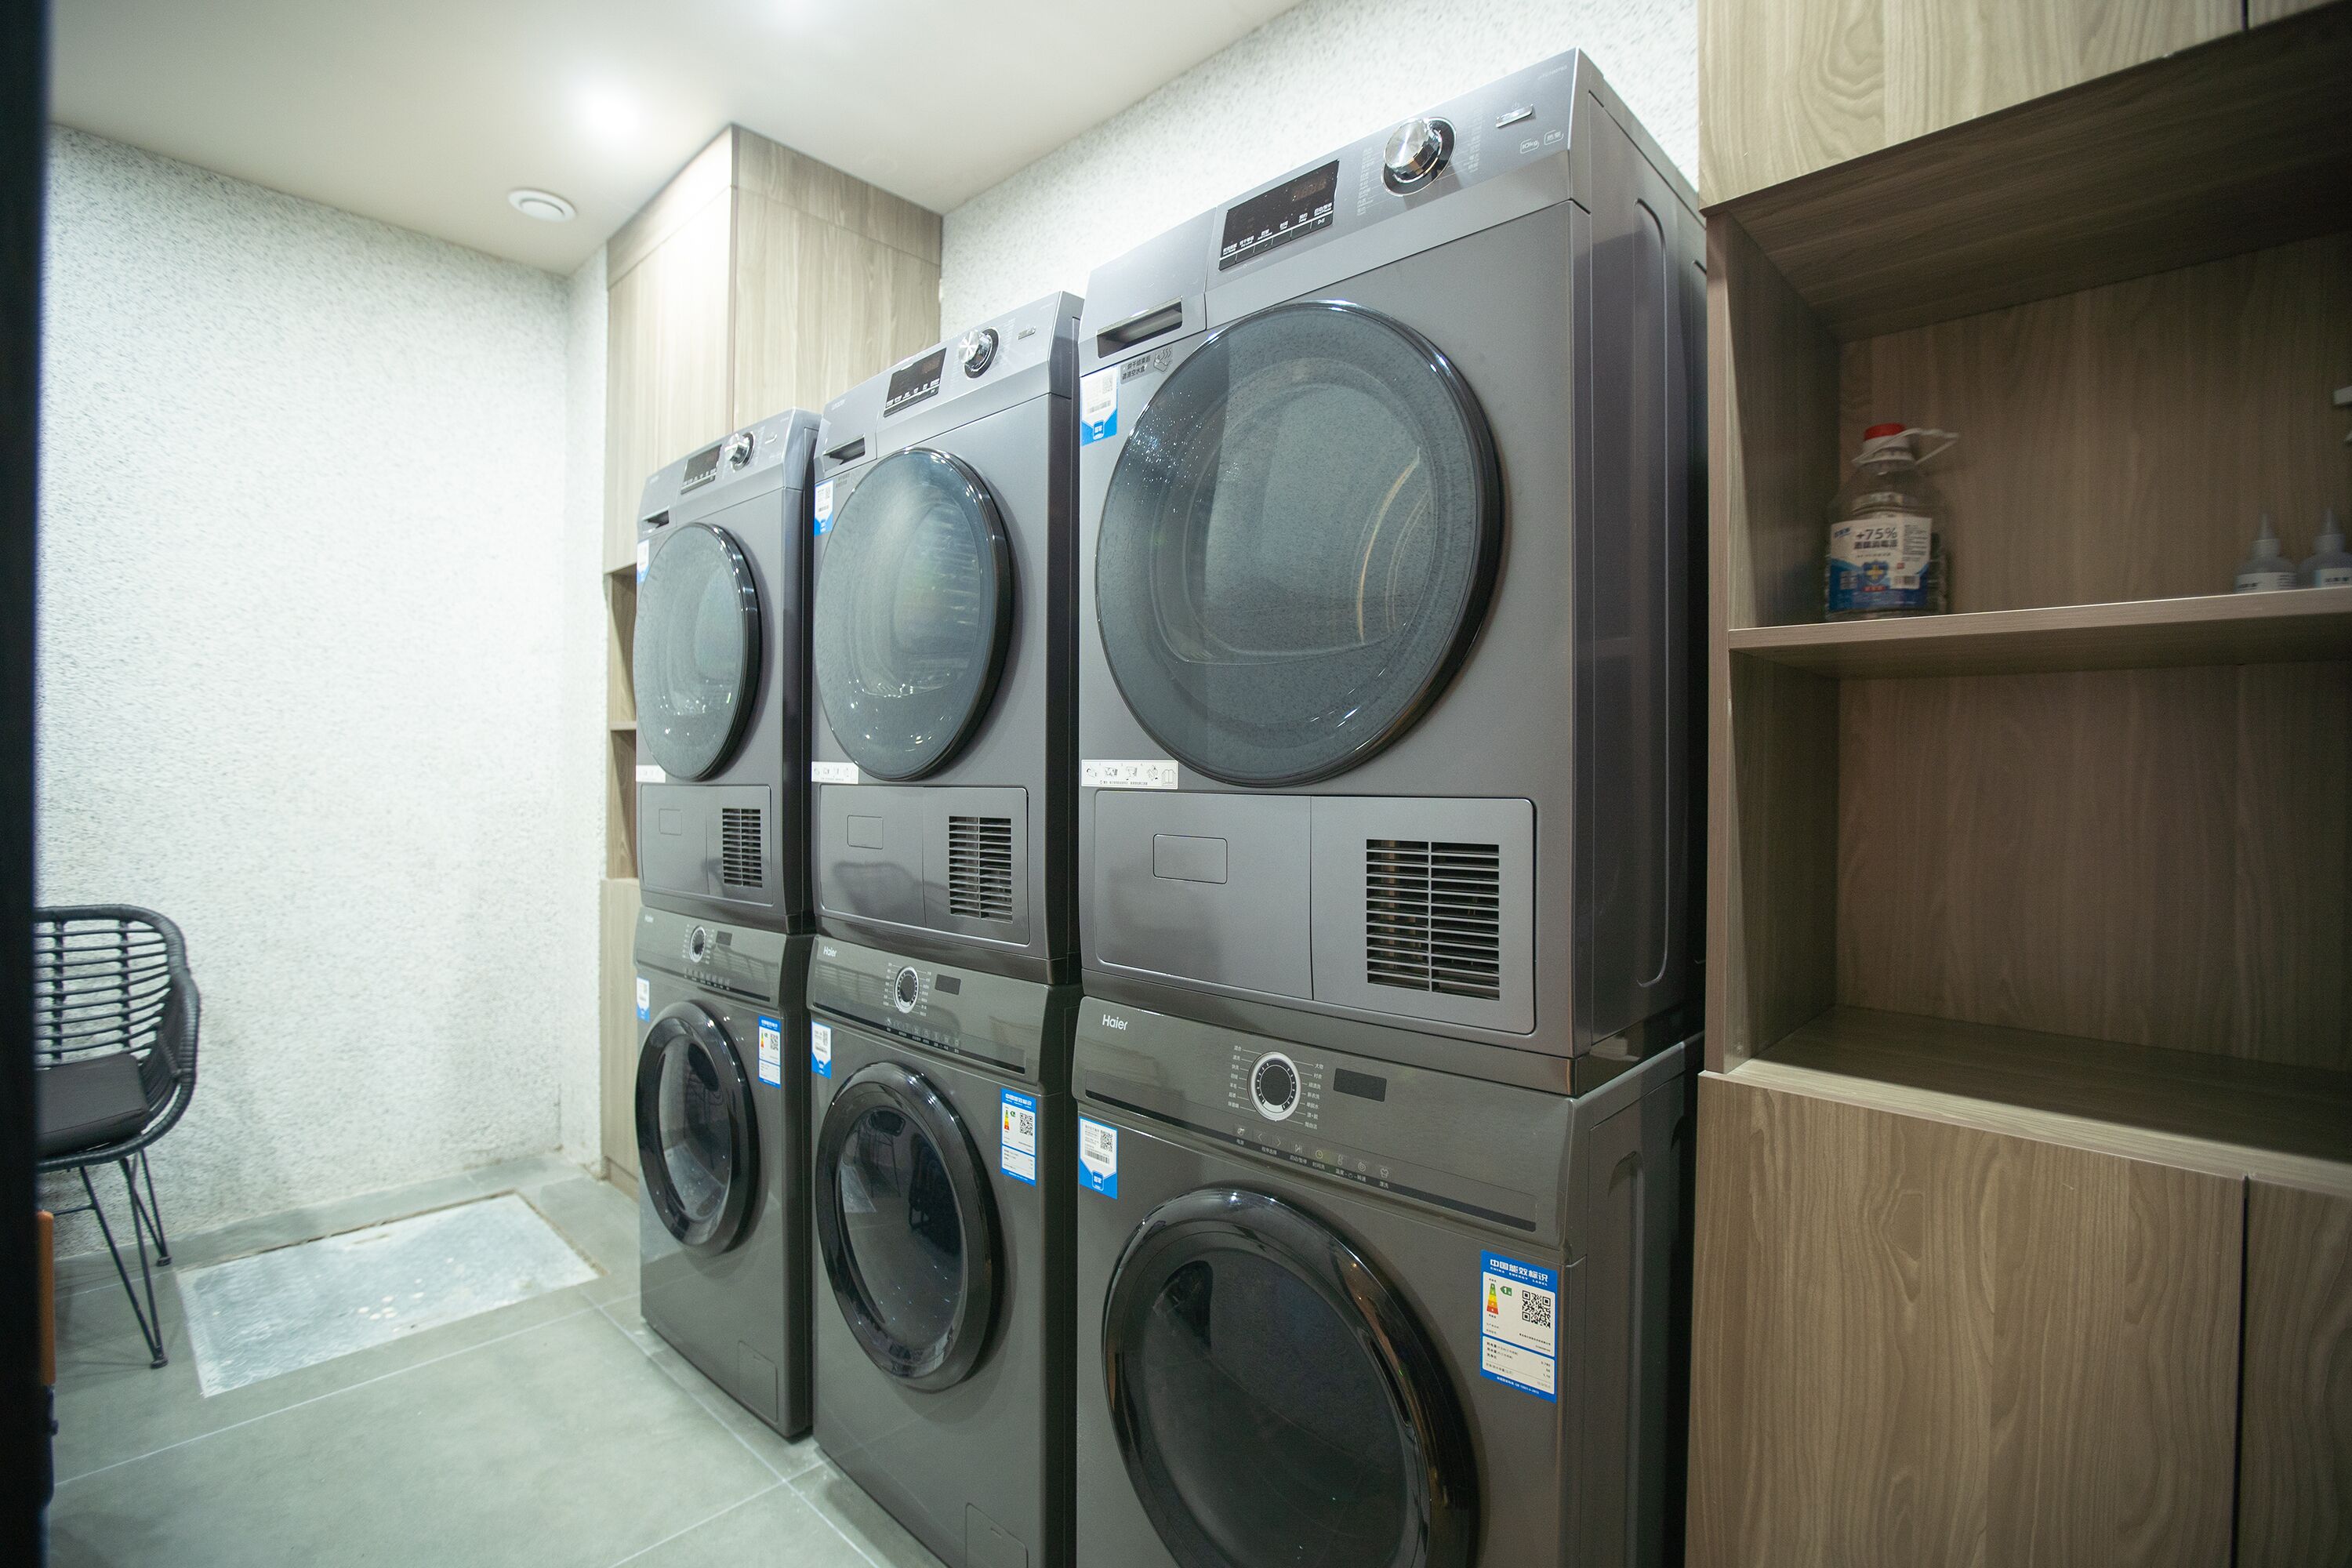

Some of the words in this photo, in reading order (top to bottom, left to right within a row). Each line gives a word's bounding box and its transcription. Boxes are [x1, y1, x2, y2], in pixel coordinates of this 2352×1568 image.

[1102, 1014, 1128, 1031] Haier
[1490, 1258, 1548, 1282] 中国能效标识
